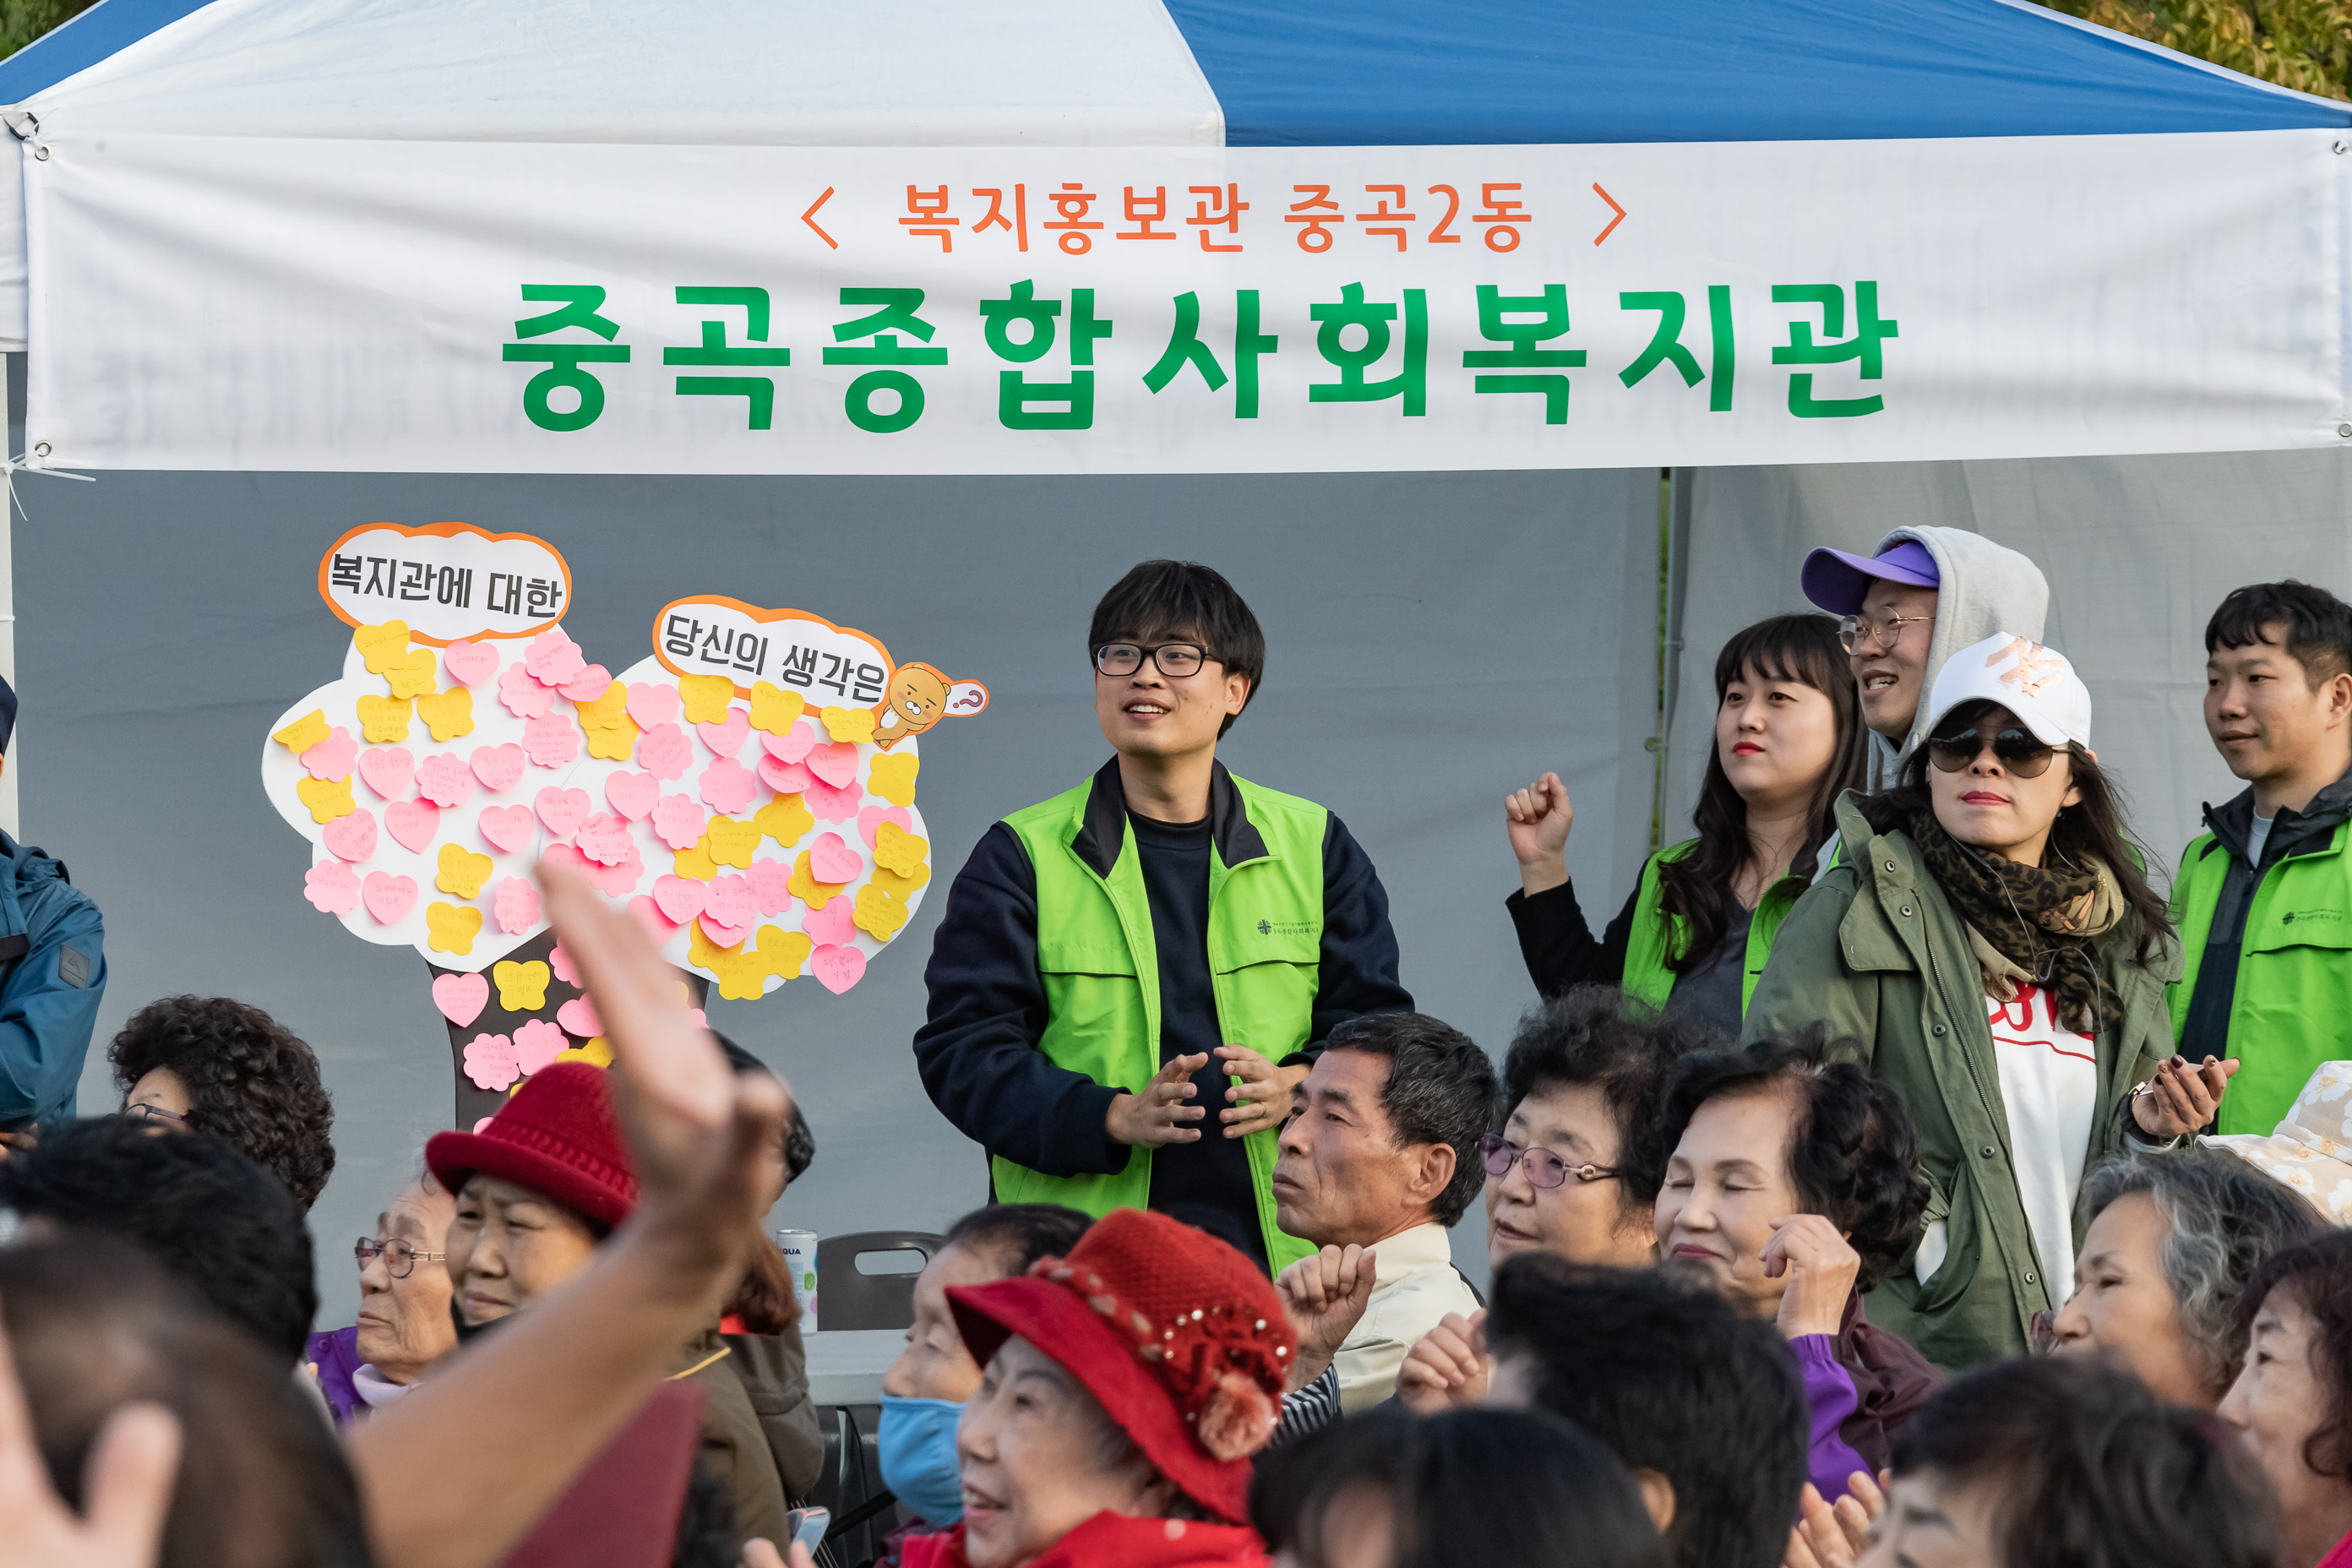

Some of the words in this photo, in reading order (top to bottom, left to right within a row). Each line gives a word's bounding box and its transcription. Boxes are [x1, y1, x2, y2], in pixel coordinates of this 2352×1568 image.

[899, 183, 1250, 255] 복지홍보관
[1285, 182, 1531, 253] 중곡2동
[503, 280, 1898, 433] 중곡종합사회복지관
[332, 553, 473, 608] 복지관에
[487, 572, 563, 618] 대한
[666, 613, 769, 677] 당신의
[781, 645, 885, 703] 생각은
